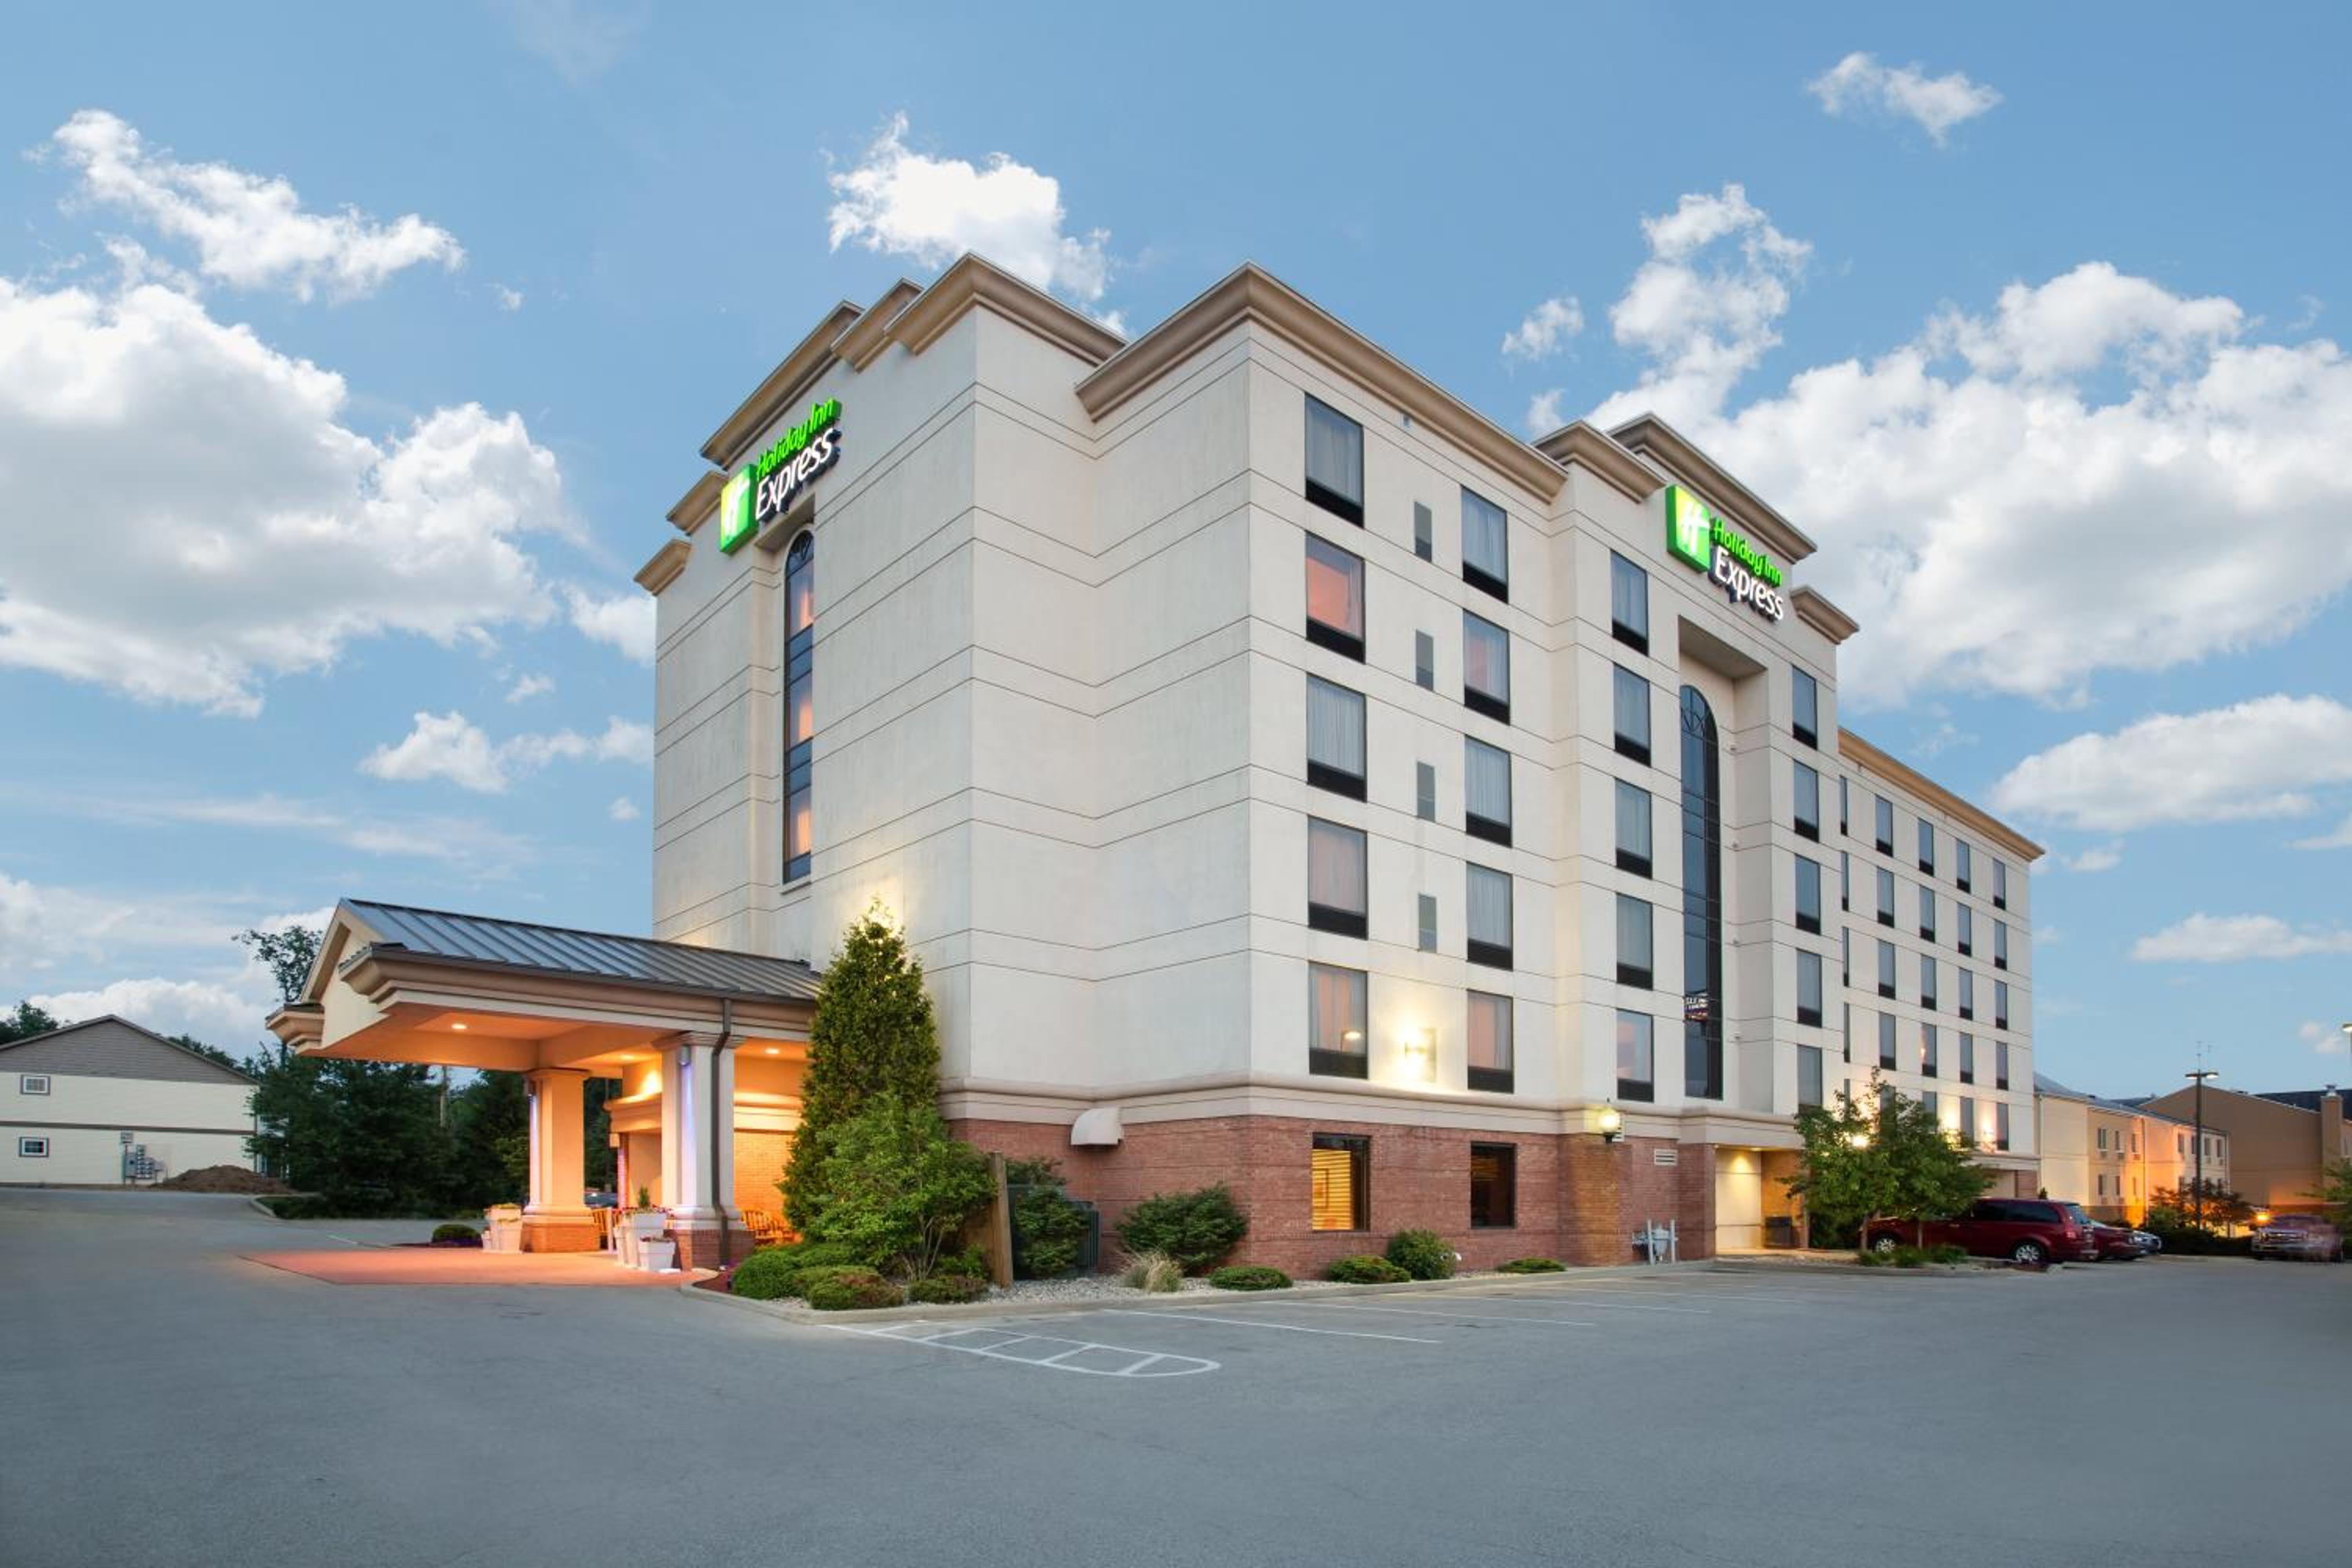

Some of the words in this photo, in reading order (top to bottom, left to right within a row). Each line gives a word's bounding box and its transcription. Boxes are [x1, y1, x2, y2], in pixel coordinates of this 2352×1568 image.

[756, 427, 833, 521] Express
[757, 420, 808, 482] Holiday
[809, 399, 833, 433] Inn
[1714, 517, 1762, 575] Holiday
[1763, 555, 1782, 586] Inn
[1715, 545, 1784, 620] Express
